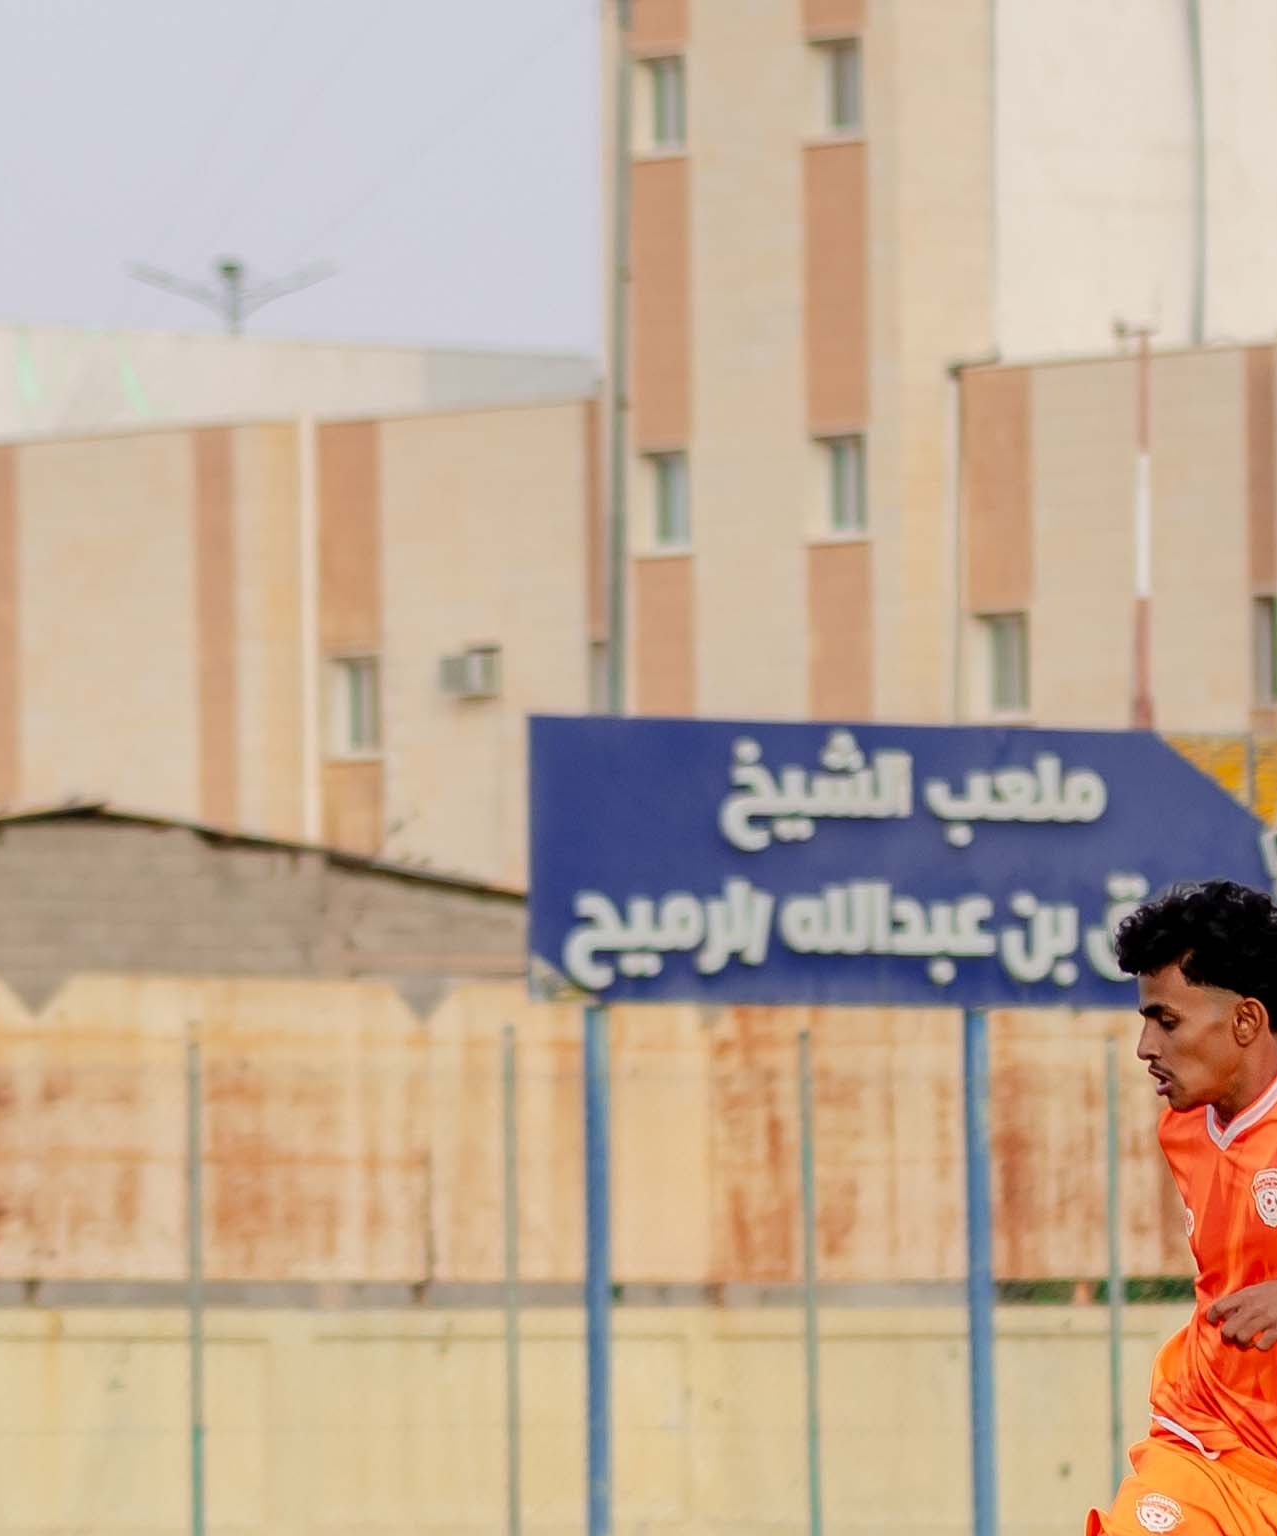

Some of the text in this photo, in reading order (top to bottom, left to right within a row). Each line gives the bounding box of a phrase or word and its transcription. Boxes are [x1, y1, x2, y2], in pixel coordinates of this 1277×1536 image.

[718, 728, 1109, 853] ملعب الشيخ
[561, 877, 775, 992] الرميح
[780, 879, 998, 986] عبدالله
[999, 892, 1079, 986] بن
